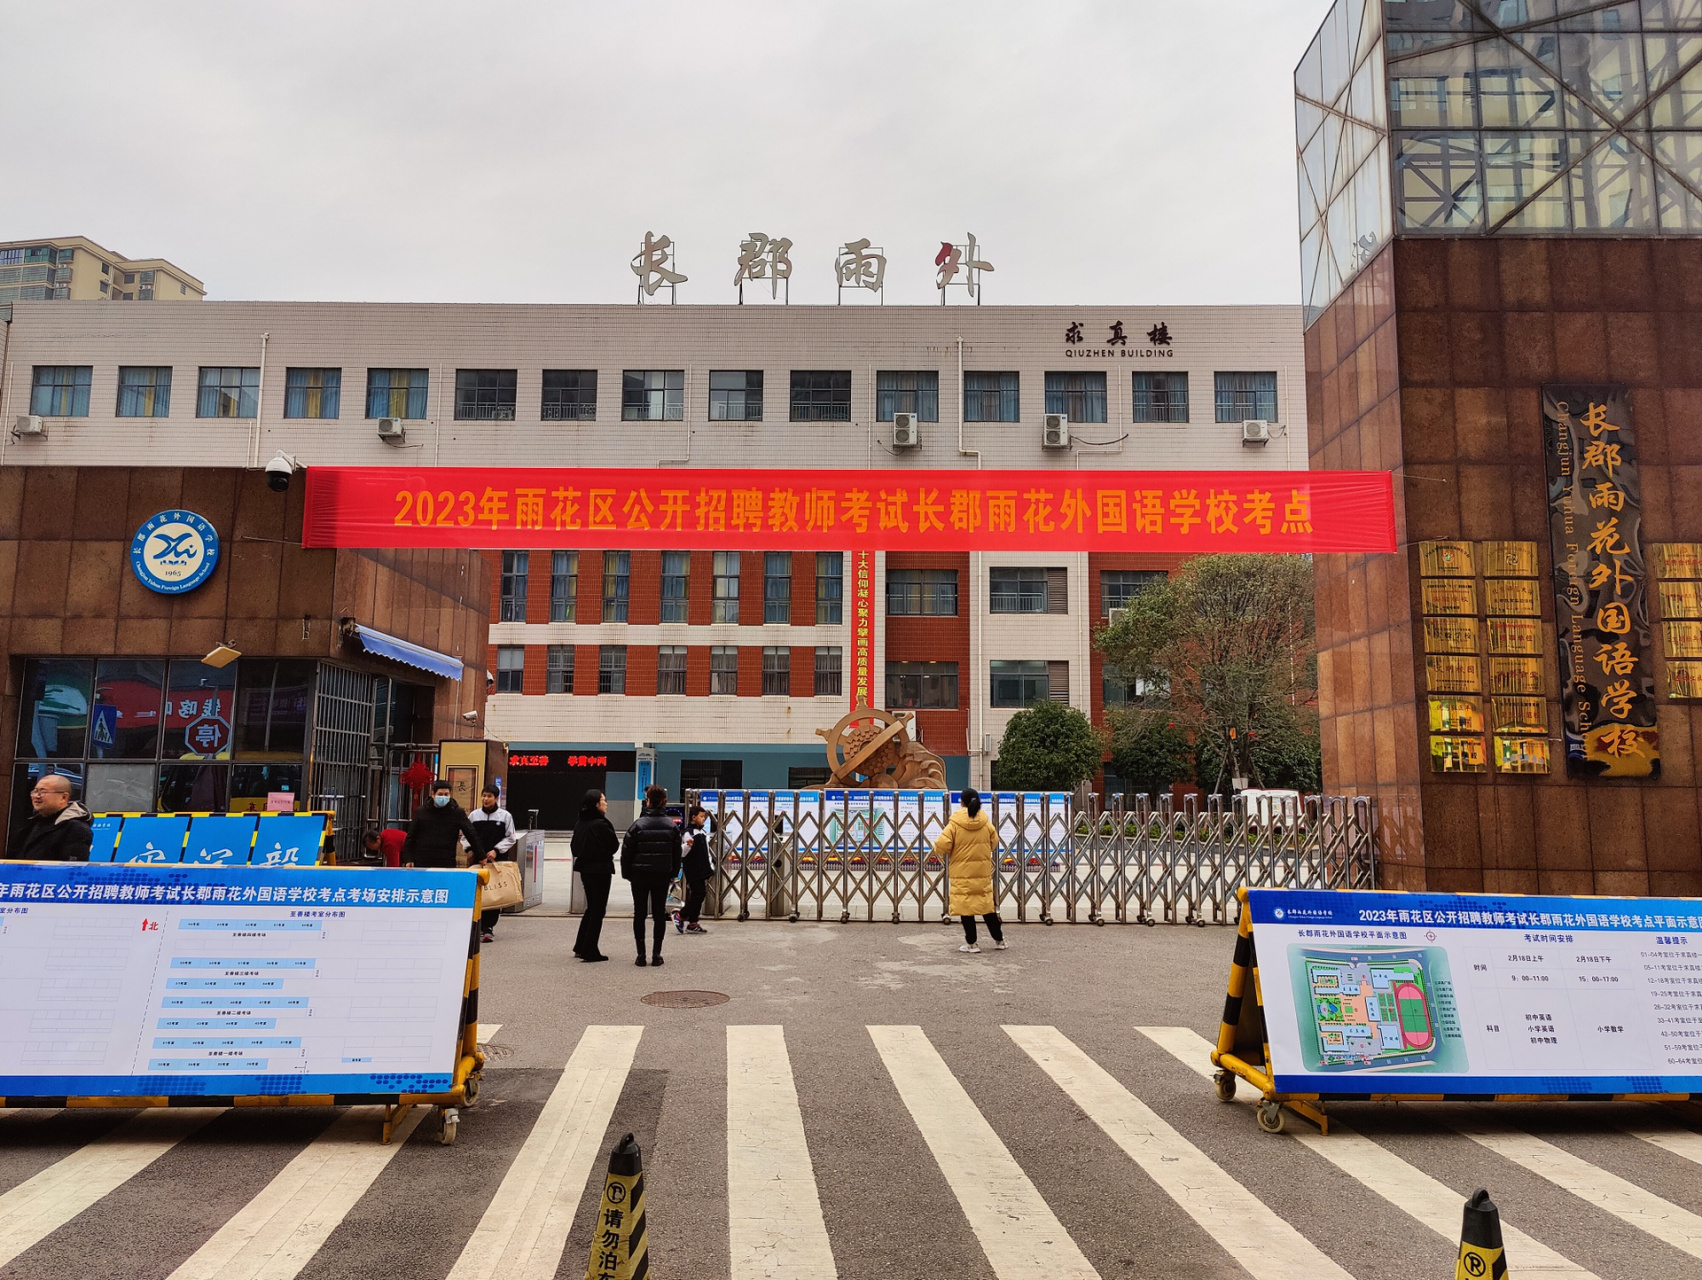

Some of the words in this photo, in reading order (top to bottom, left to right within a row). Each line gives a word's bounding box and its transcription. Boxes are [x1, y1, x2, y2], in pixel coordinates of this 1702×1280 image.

[631, 231, 994, 300] 长郡雨外
[1065, 320, 1173, 346] 求真楼
[1065, 349, 1115, 358] QIUZHEN
[1120, 349, 1174, 358] BUILDING
[1556, 401, 1571, 476] Changjun
[394, 487, 1313, 534] 2023年雨花区公开招聘教师考试长郡雨花外国语学校考点
[1562, 485, 1576, 534] Yuhua
[132, 512, 216, 556] 长郡雨花外国语学校
[1566, 543, 1580, 606] Foreign
[1580, 401, 1645, 759] 长郡雨花外国语学校
[1570, 614, 1586, 693] Language
[509, 755, 549, 767] 求真至善
[149, 922, 159, 931] 北
[1298, 929, 1408, 940] 长郡雨花外国语学校平面示意图
[1523, 933, 1574, 943] 考试时间安排
[1656, 936, 1688, 945] 温馨提示
[1508, 954, 1544, 962] 2月18日上午
[1576, 955, 1612, 963] 2月18日下午
[1473, 964, 1487, 972] 时间
[1525, 1013, 1552, 1021] 初中英语
[1486, 1024, 1500, 1033] 科目
[1527, 1025, 1555, 1033] 小学英语
[1597, 1025, 1624, 1033] 小学数学
[1530, 1037, 1558, 1045] 初中物理
